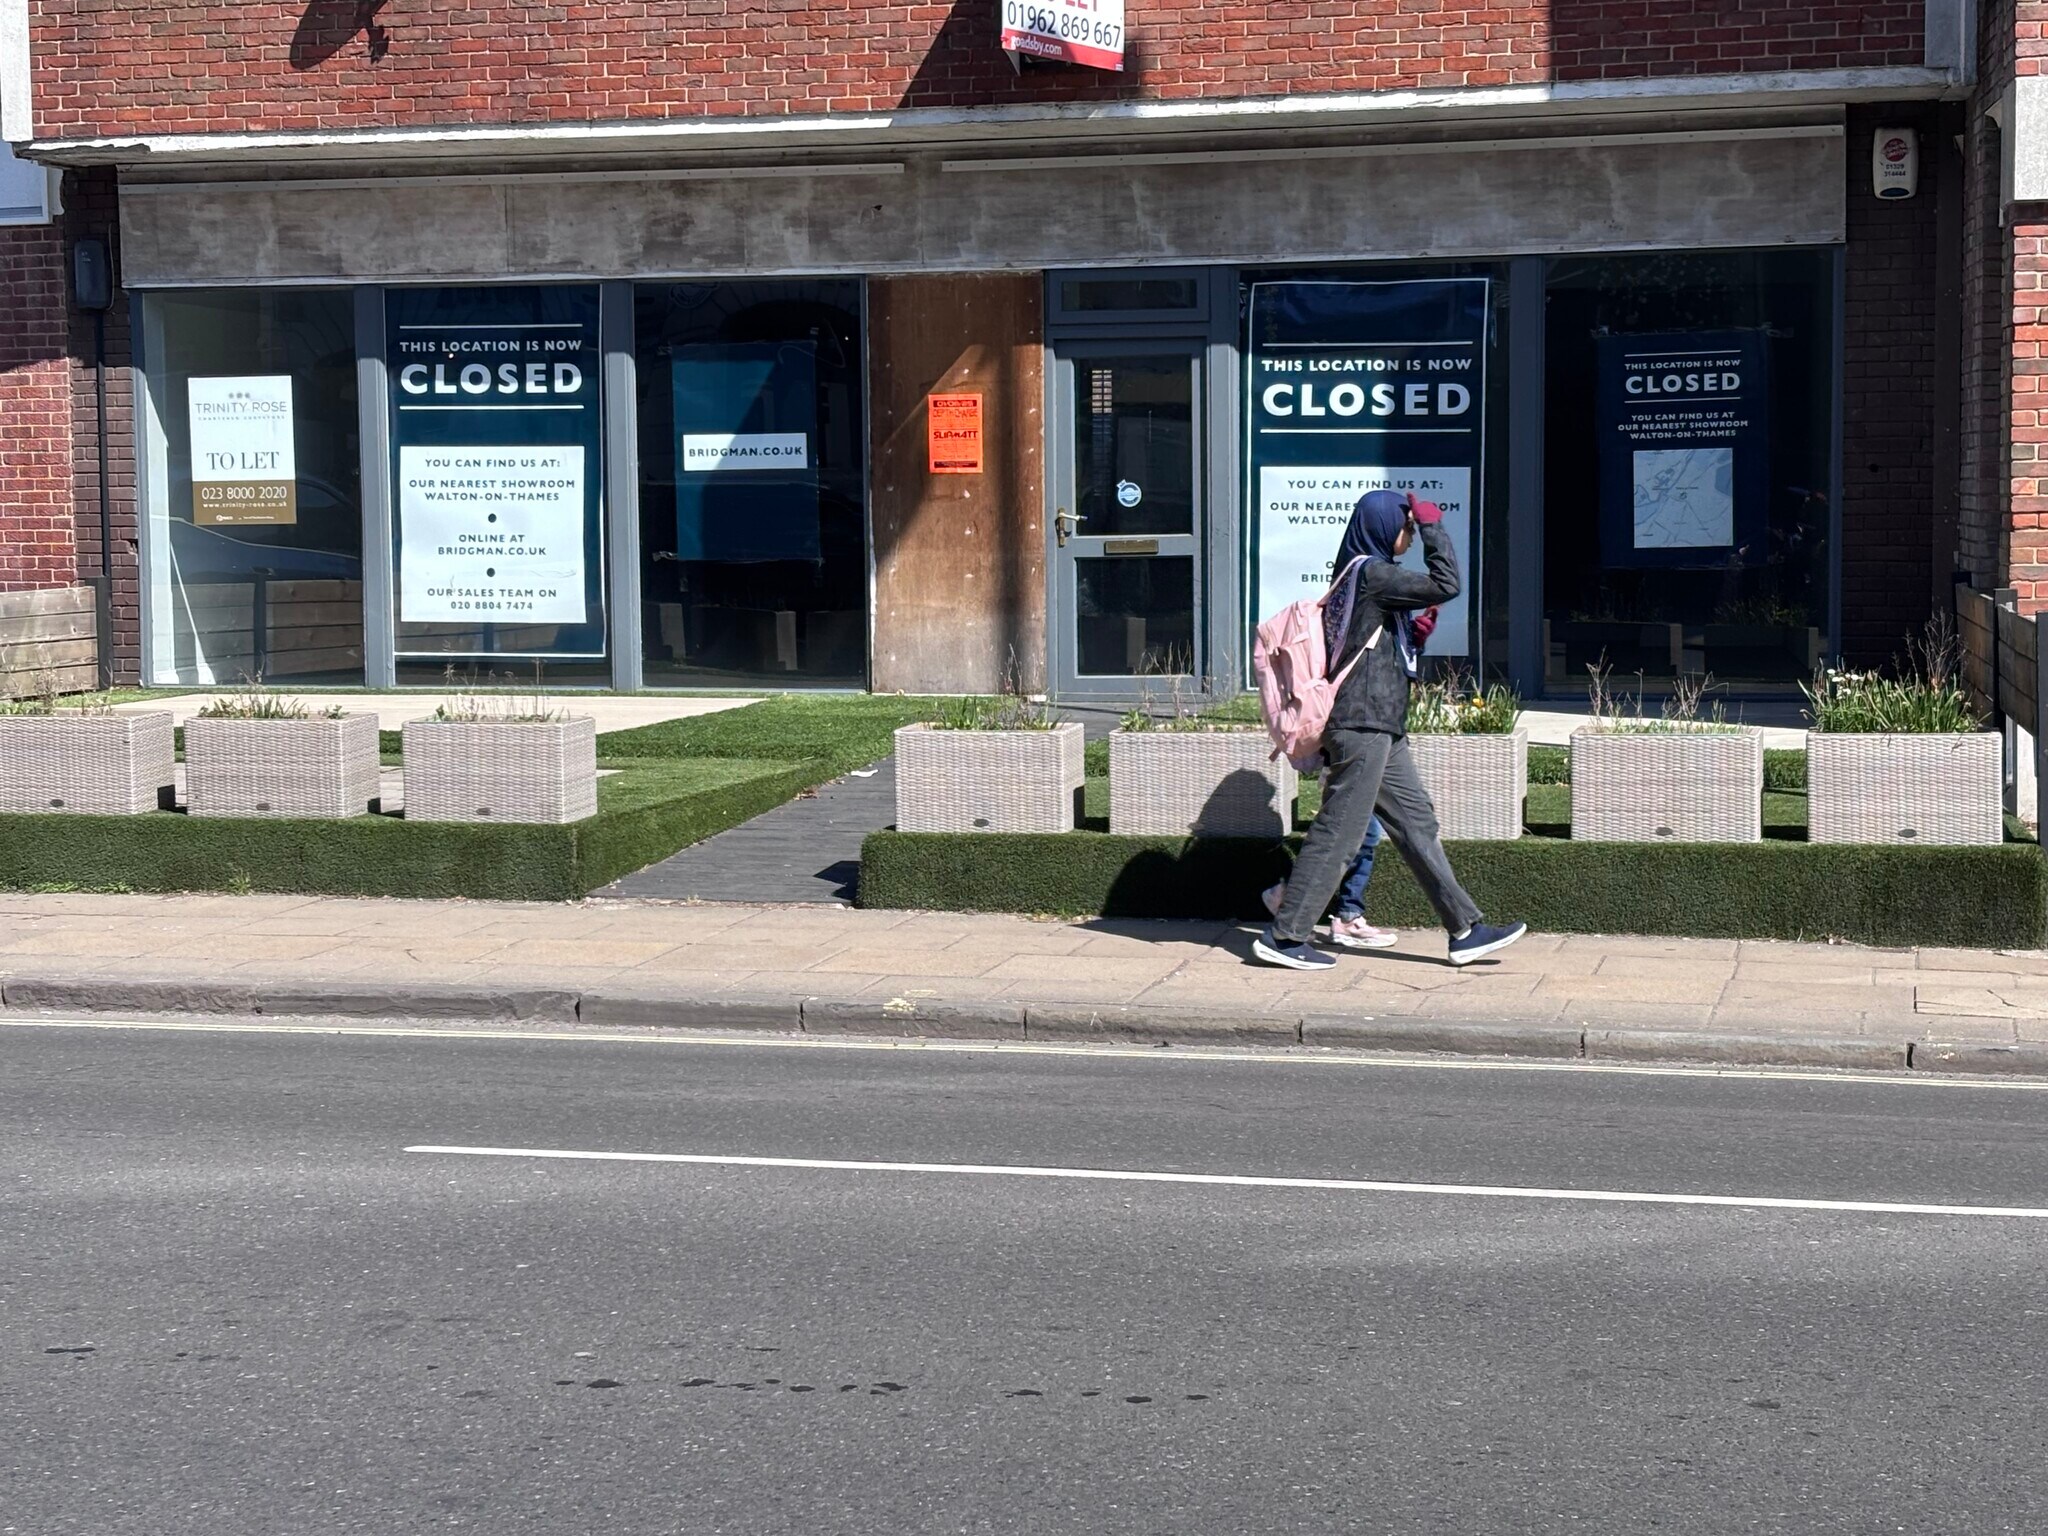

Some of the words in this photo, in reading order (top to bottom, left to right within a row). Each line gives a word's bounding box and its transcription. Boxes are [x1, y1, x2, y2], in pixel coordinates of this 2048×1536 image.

[1007, 1, 1056, 34] 01962
[1061, 14, 1090, 41] 869
[1094, 22, 1121, 48] 667
[400, 341, 436, 352] THIS
[442, 340, 520, 352] LOCATION
[526, 340, 539, 351] IS
[545, 340, 582, 351] NOW
[1261, 359, 1303, 372] THIS
[1309, 359, 1399, 372] LOCATION
[1406, 359, 1421, 371] IS
[1428, 358, 1472, 371] NOW
[1650, 361, 1700, 370] LOCATION
[1716, 359, 1741, 367] NOW
[401, 363, 583, 395] CLOSED
[1625, 372, 1740, 394] CLOSED
[1262, 383, 1471, 417] CLOSED
[195, 402, 247, 414] TRINITY
[252, 401, 288, 413] ROSE
[1631, 414, 1652, 422] YOU
[1655, 413, 1676, 421] CAN
[1679, 412, 1703, 420] FIND
[1642, 422, 1686, 430] NEAREST
[1689, 420, 1748, 429] SHOWROOM
[1630, 429, 1737, 440] WALTON-ON-THAMES
[689, 446, 804, 457] BRIDGMAN.CO.UK
[206, 452, 235, 471] TO
[241, 451, 280, 470] LET
[425, 459, 450, 467] YOU
[455, 459, 481, 467] CAN
[486, 459, 516, 467] FIND
[520, 459, 536, 467] US
[540, 459, 560, 467] AT:
[409, 479, 435, 488] OUR
[440, 479, 497, 488] NEAREST
[501, 479, 575, 488] SHOWROOM
[1287, 480, 1317, 489] YOU
[1322, 480, 1352, 489] CAN
[1358, 480, 1391, 489] FIND
[1397, 480, 1415, 489] US
[1420, 480, 1444, 489] AT:
[201, 487, 223, 500] 023
[226, 486, 255, 500] 8000
[258, 486, 287, 499] 2020
[424, 492, 560, 501] WALTON-ON-THAMES
[1270, 502, 1299, 511] OUR
[1305, 502, 1359, 511] NEARES
[458, 534, 505, 543] ONLINE
[509, 534, 526, 543] AT
[437, 547, 547, 556] BRIDGMAN.CO.UK
[427, 588, 453, 597] OUR
[457, 588, 494, 597] SALES
[499, 588, 534, 597] TEAM
[538, 589, 557, 598] ON
[450, 601, 471, 610] 020
[475, 601, 502, 610] 8804
[506, 601, 533, 610] 7474
